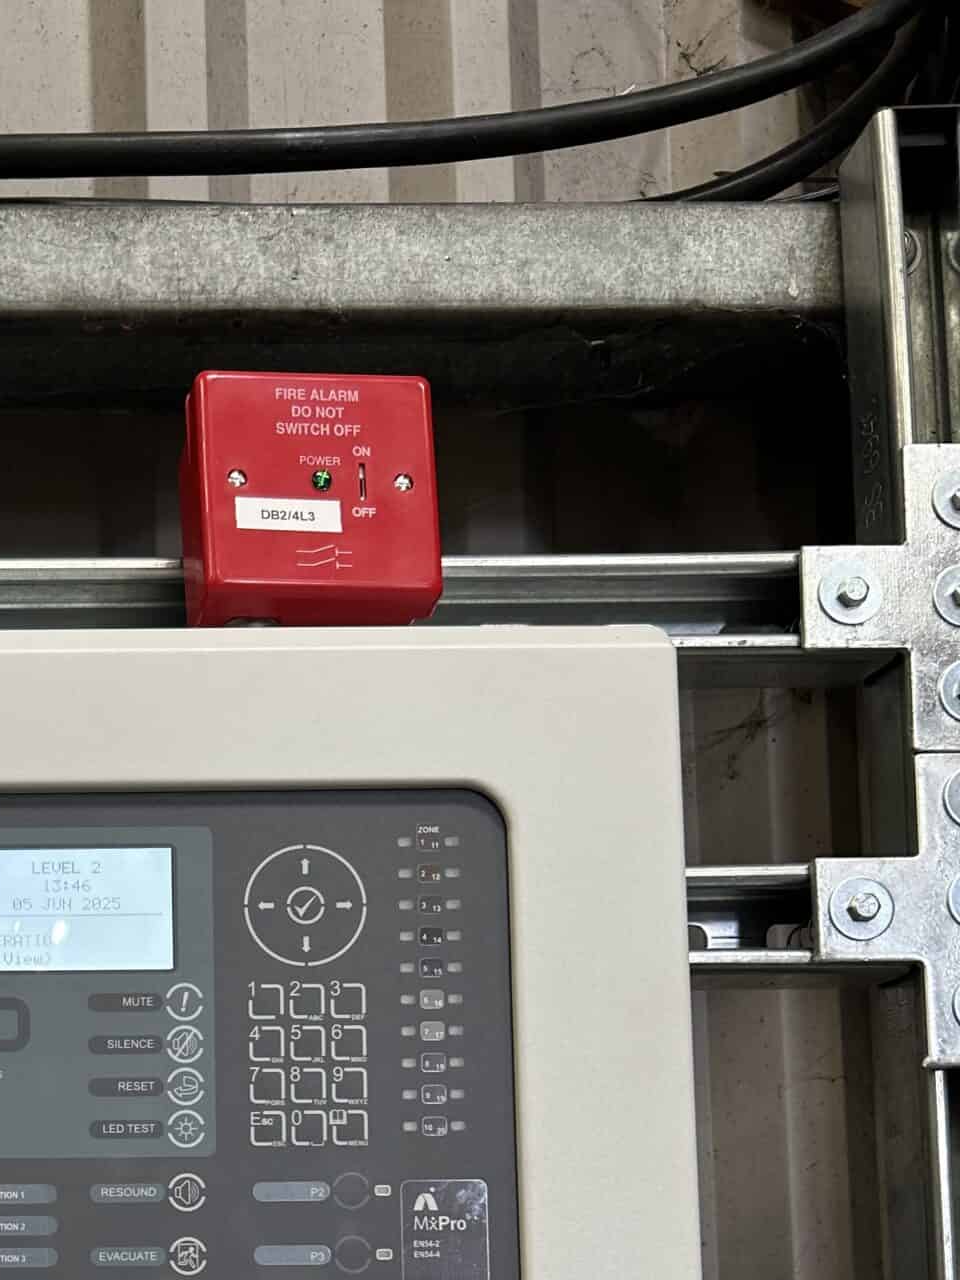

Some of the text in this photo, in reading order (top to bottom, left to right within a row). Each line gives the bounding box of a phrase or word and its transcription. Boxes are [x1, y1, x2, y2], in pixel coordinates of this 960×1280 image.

[275, 387, 359, 402] FIRE ALARM
[291, 405, 344, 419] DO NOT
[276, 422, 361, 437] SWITCH OFF
[352, 446, 371, 457] ON
[299, 455, 341, 466] POWER
[260, 509, 316, 522] DB2/4L3
[352, 507, 377, 518] OFF
[417, 825, 441, 834] ZONE
[31, 861, 102, 875] LEVEL 2
[43, 879, 91, 893] 13:46
[11, 897, 33, 912] 05
[82, 897, 121, 911] 2025
[3, 952, 52, 968] View)
[248, 981, 256, 997] 1
[289, 980, 301, 997] 2
[330, 980, 341, 997] 3
[122, 996, 154, 1008] MUTE
[248, 1025, 261, 1041] 4
[290, 1024, 302, 1040] 5
[331, 1023, 343, 1040] 6
[106, 1038, 155, 1050] SILENCE
[249, 1066, 261, 1082] 7
[290, 1066, 301, 1082] 8
[332, 1066, 344, 1082] 9
[117, 1081, 155, 1092] RESET
[250, 1111, 273, 1126] Esc
[291, 1109, 303, 1126] 0
[102, 1123, 156, 1135] LED TEST
[20, 1191, 25, 1200] 1
[100, 1187, 157, 1198] RESOUND
[310, 1187, 326, 1199] P2
[18, 1222, 26, 1232] 2
[413, 1215, 467, 1231] MxPro
[20, 1254, 26, 1264] 3
[98, 1251, 158, 1262] EVACUATE
[310, 1251, 326, 1263] P3
